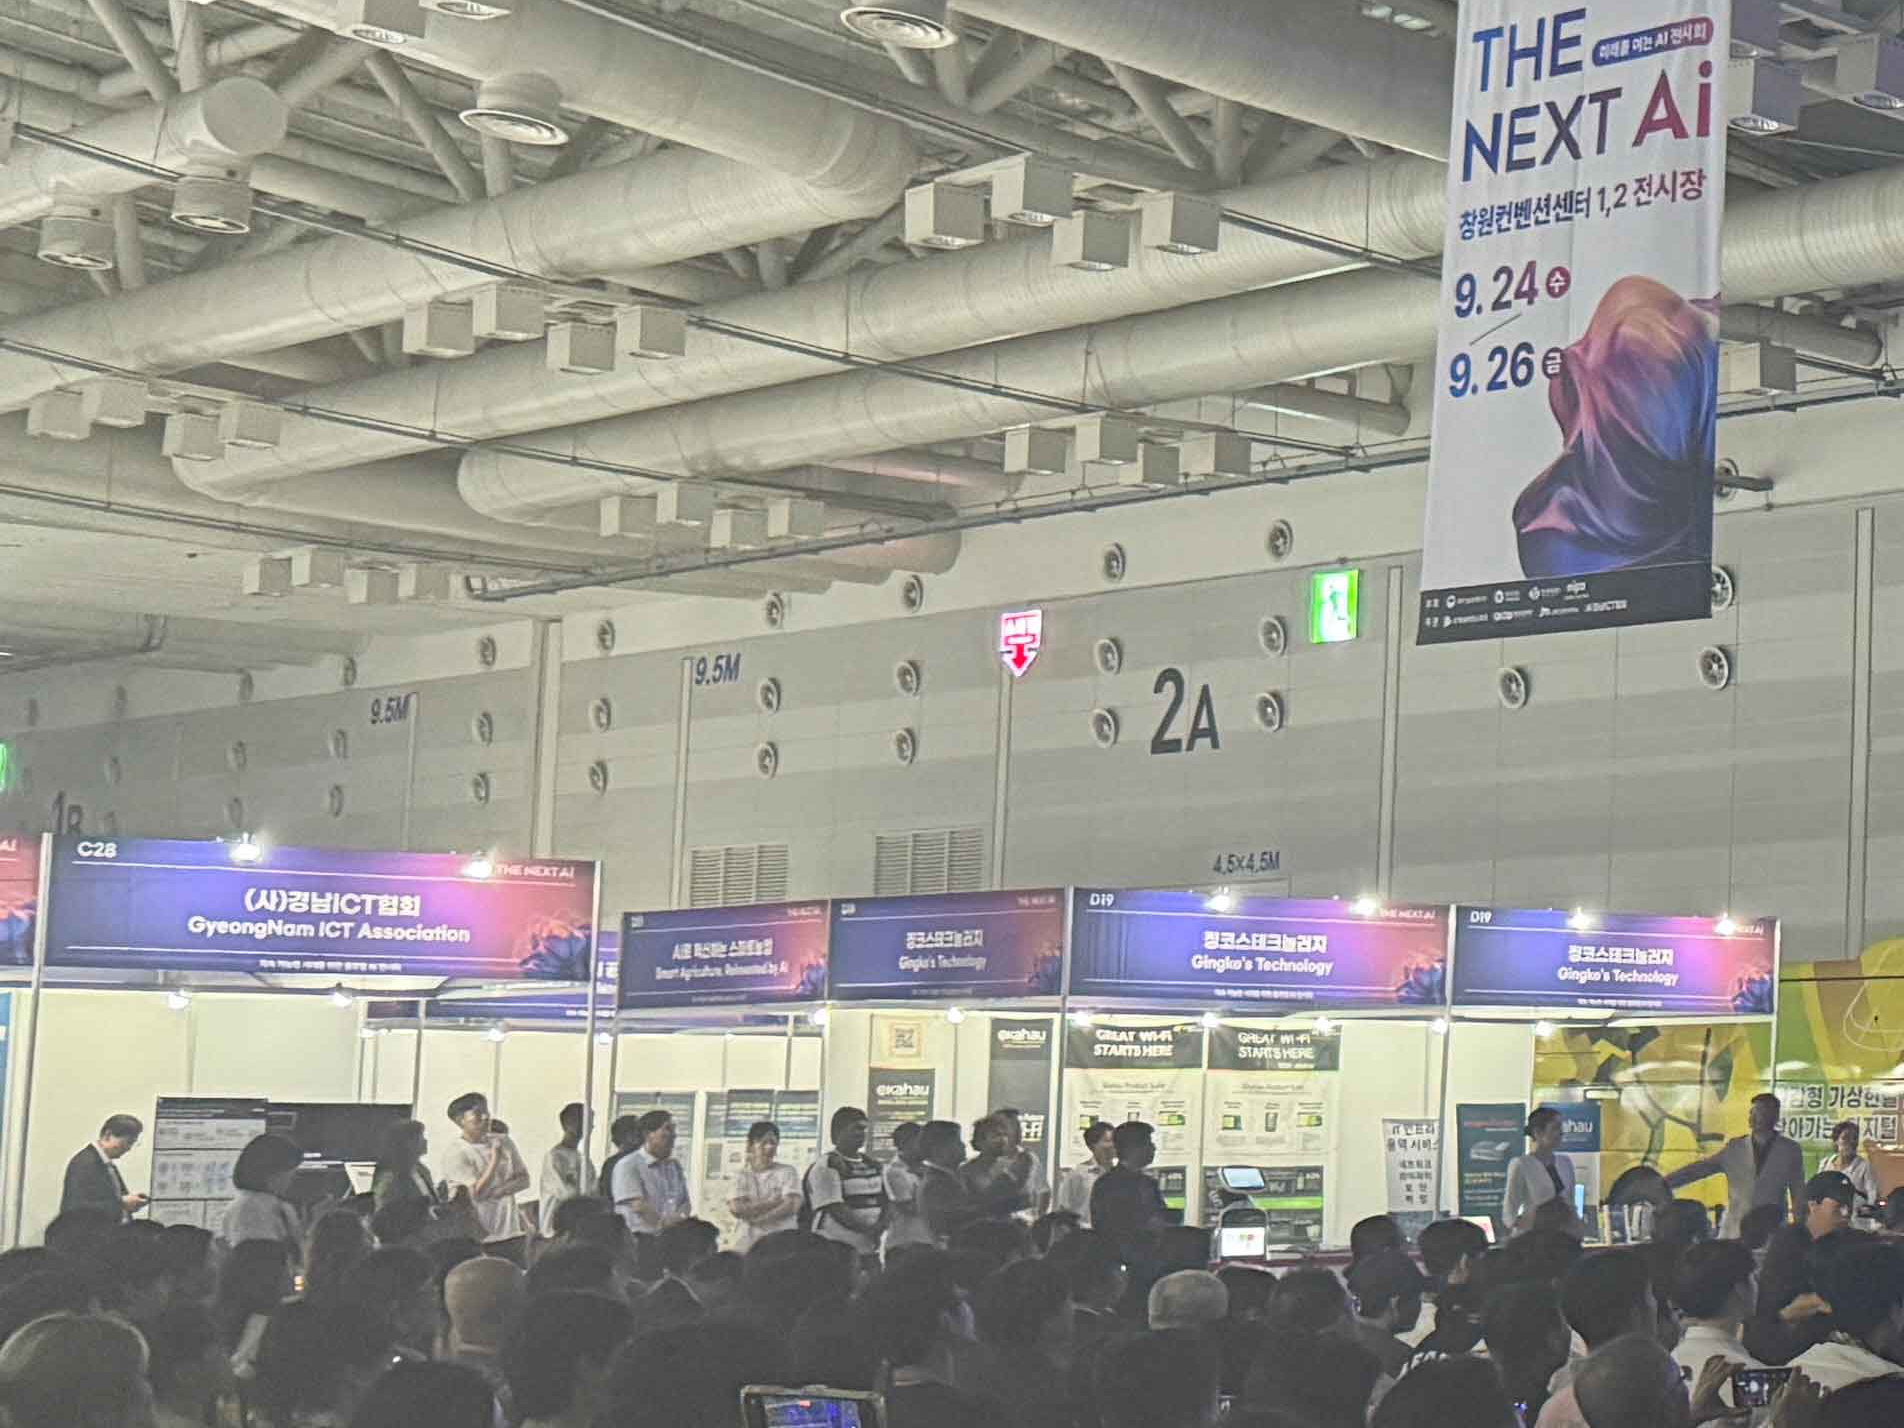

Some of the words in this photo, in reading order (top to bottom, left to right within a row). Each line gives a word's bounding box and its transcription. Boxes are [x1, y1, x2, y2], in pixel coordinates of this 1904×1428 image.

[1471, 7, 1586, 93] THE
[1462, 86, 1623, 183] NEXT
[1631, 60, 1713, 148] Ai
[1459, 186, 1591, 242] 창원컨벤션센터
[1597, 182, 1627, 218] 1,2
[1633, 168, 1707, 208] 전시장
[695, 652, 742, 686] 9.5M
[1150, 668, 1221, 755] 2A
[77, 841, 118, 859] C28
[244, 887, 422, 918] (사)경남ICT협회
[187, 914, 315, 942] GyeongNam
[318, 920, 354, 939] ICT
[356, 922, 472, 943] Association
[1256, 957, 1335, 976] Technology
[1612, 968, 1680, 987] Technology
[1857, 1115, 1897, 1140] 지털
